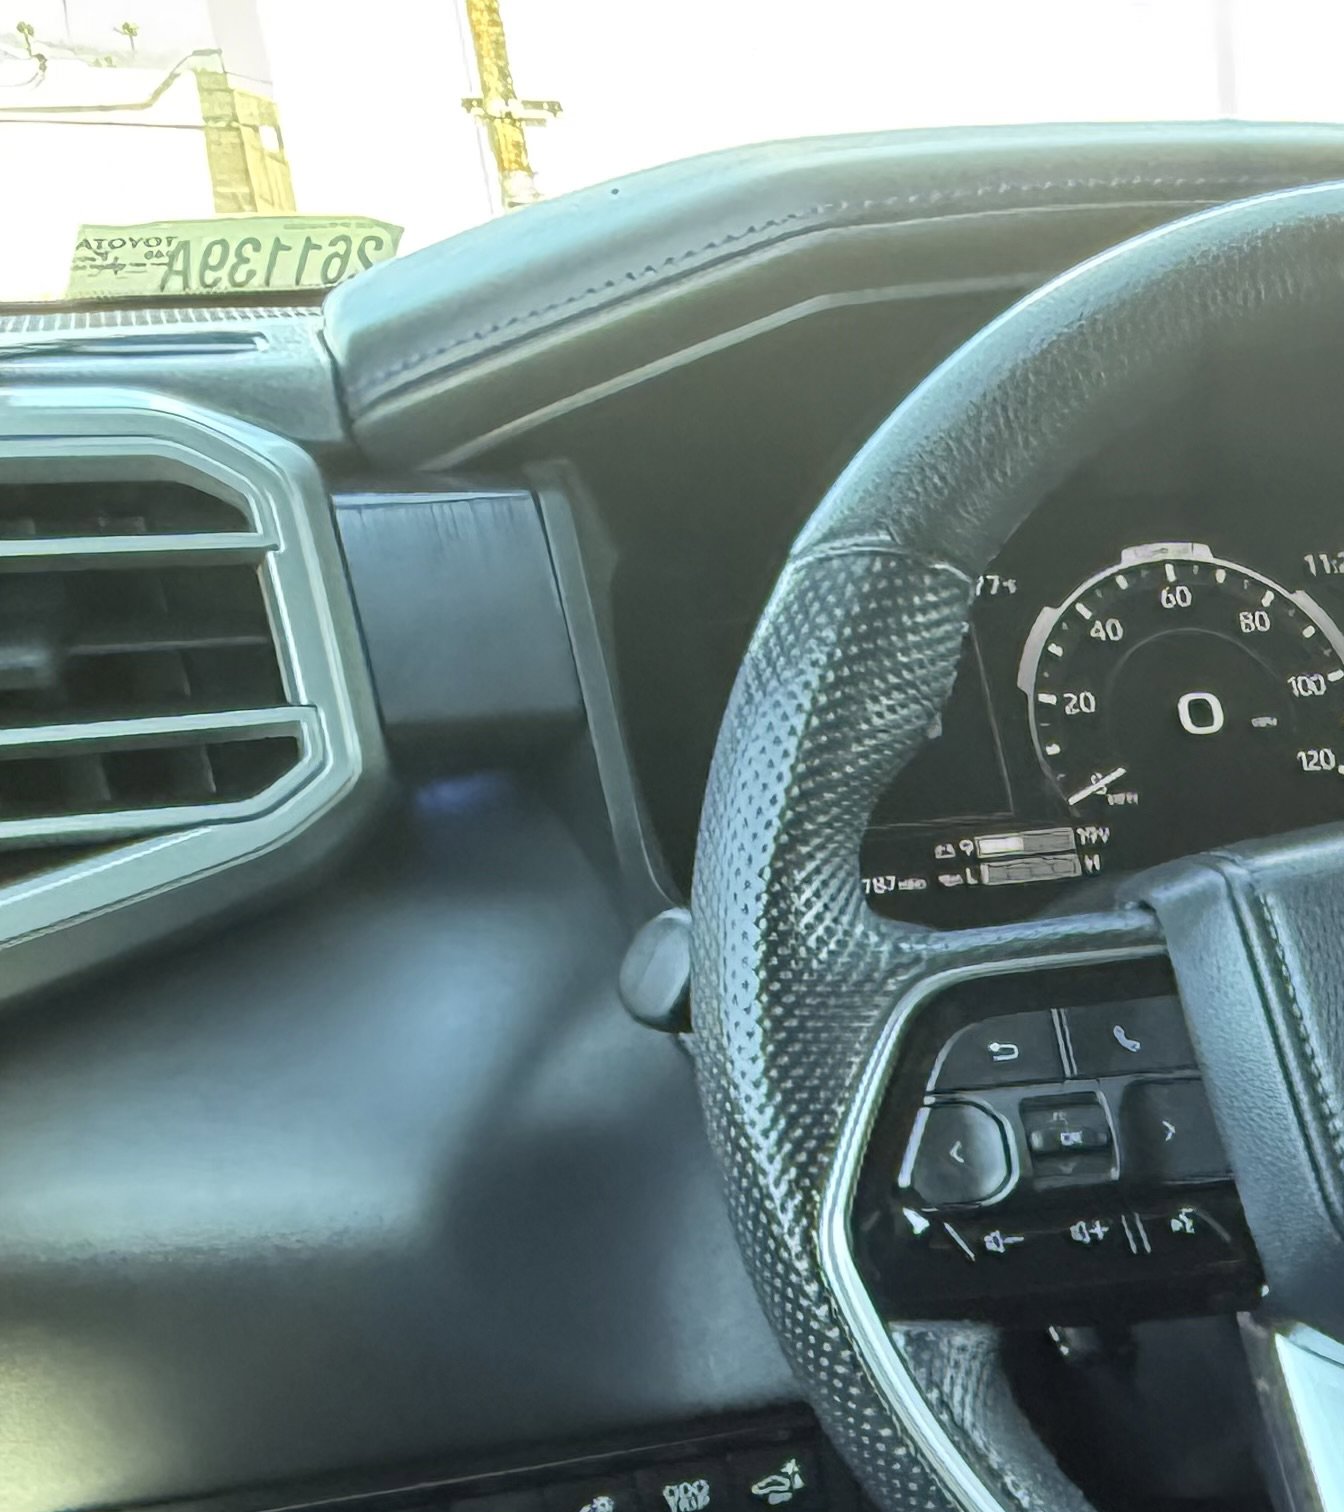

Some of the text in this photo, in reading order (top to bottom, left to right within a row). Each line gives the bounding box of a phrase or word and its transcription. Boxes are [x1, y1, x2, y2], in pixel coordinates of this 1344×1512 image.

[1160, 584, 1192, 609] 60
[1089, 617, 1124, 642] 40
[1239, 610, 1272, 634] 80
[1287, 673, 1328, 698] 100
[1063, 691, 1097, 716] 20
[1177, 691, 1225, 735] 0
[1296, 747, 1337, 772] 120
